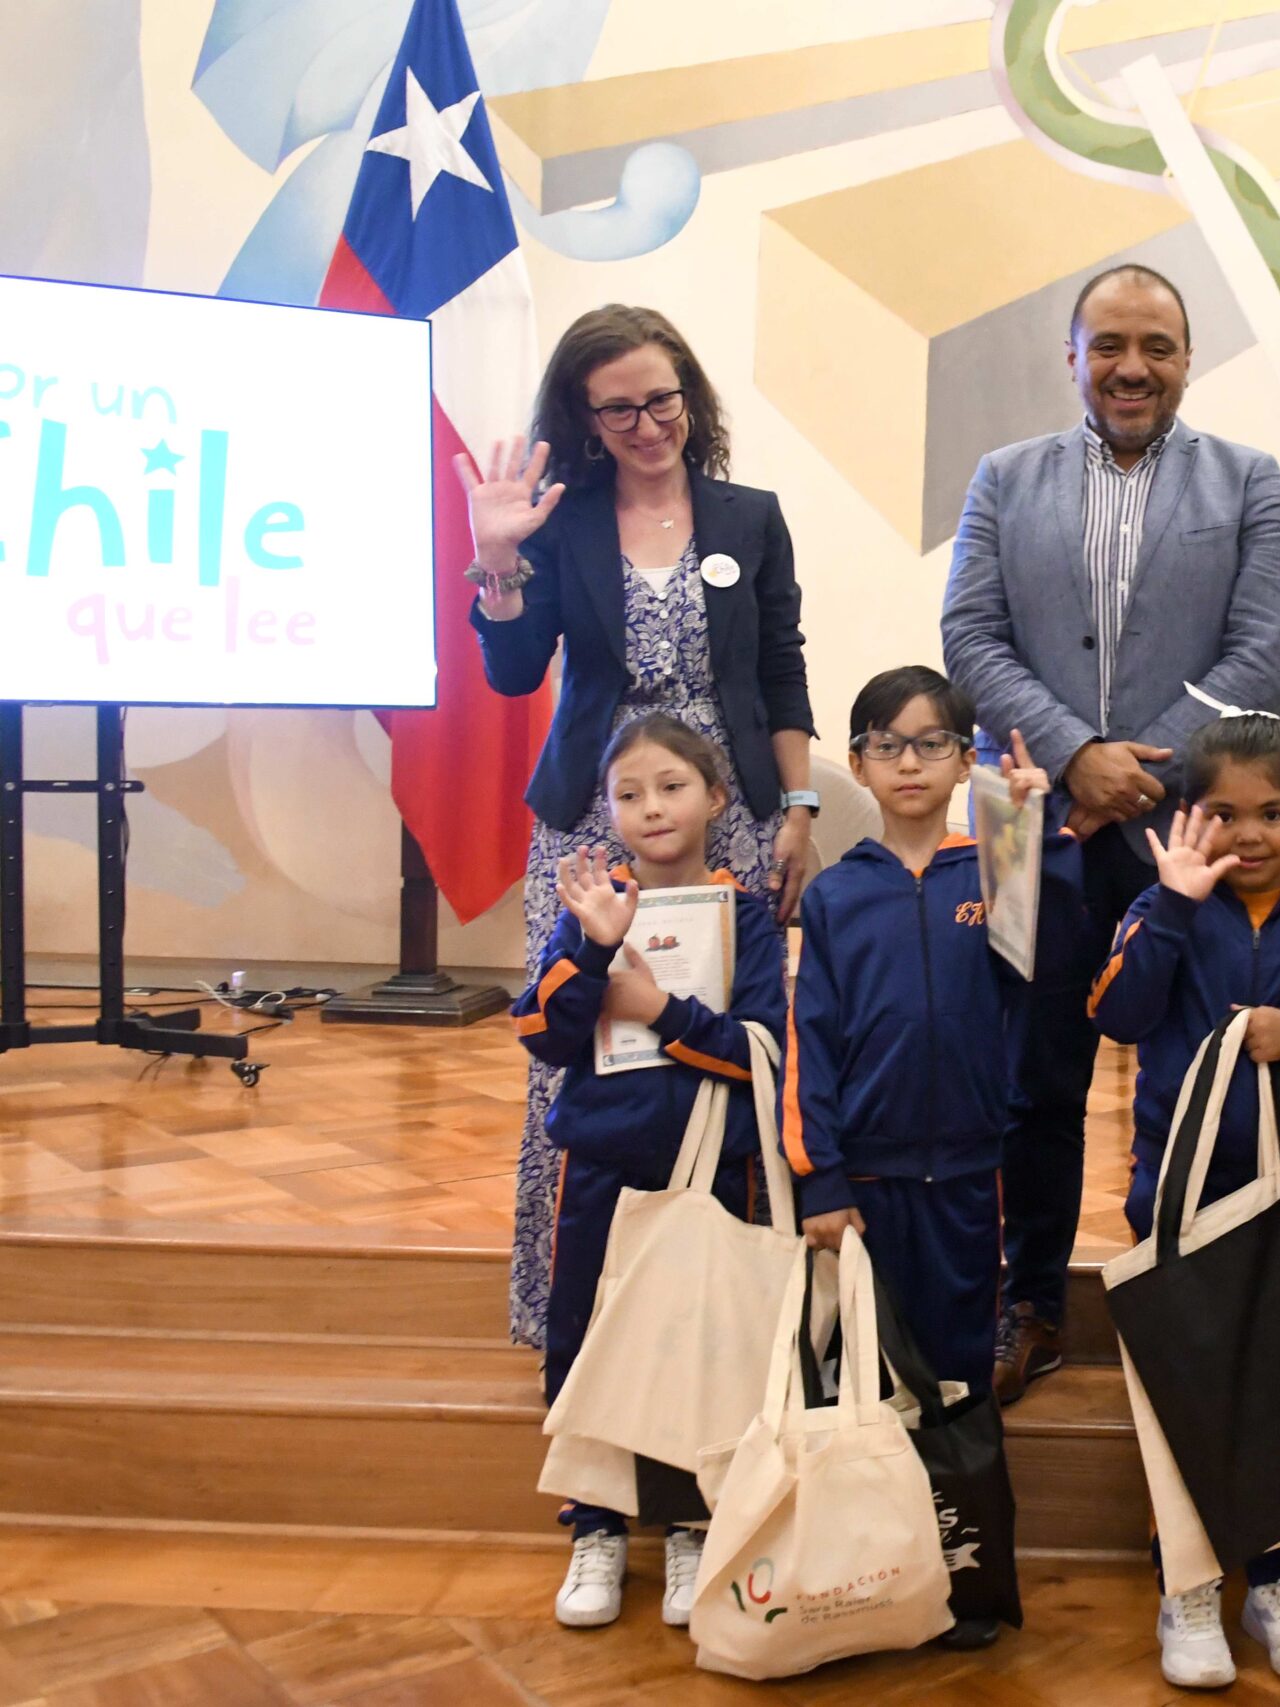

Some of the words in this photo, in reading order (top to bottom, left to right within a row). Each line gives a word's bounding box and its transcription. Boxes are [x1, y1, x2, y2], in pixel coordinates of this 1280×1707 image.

[0, 363, 58, 408] or
[91, 382, 177, 424] un
[0, 418, 305, 587] hile
[67, 593, 193, 665] que
[225, 575, 316, 653] lee
